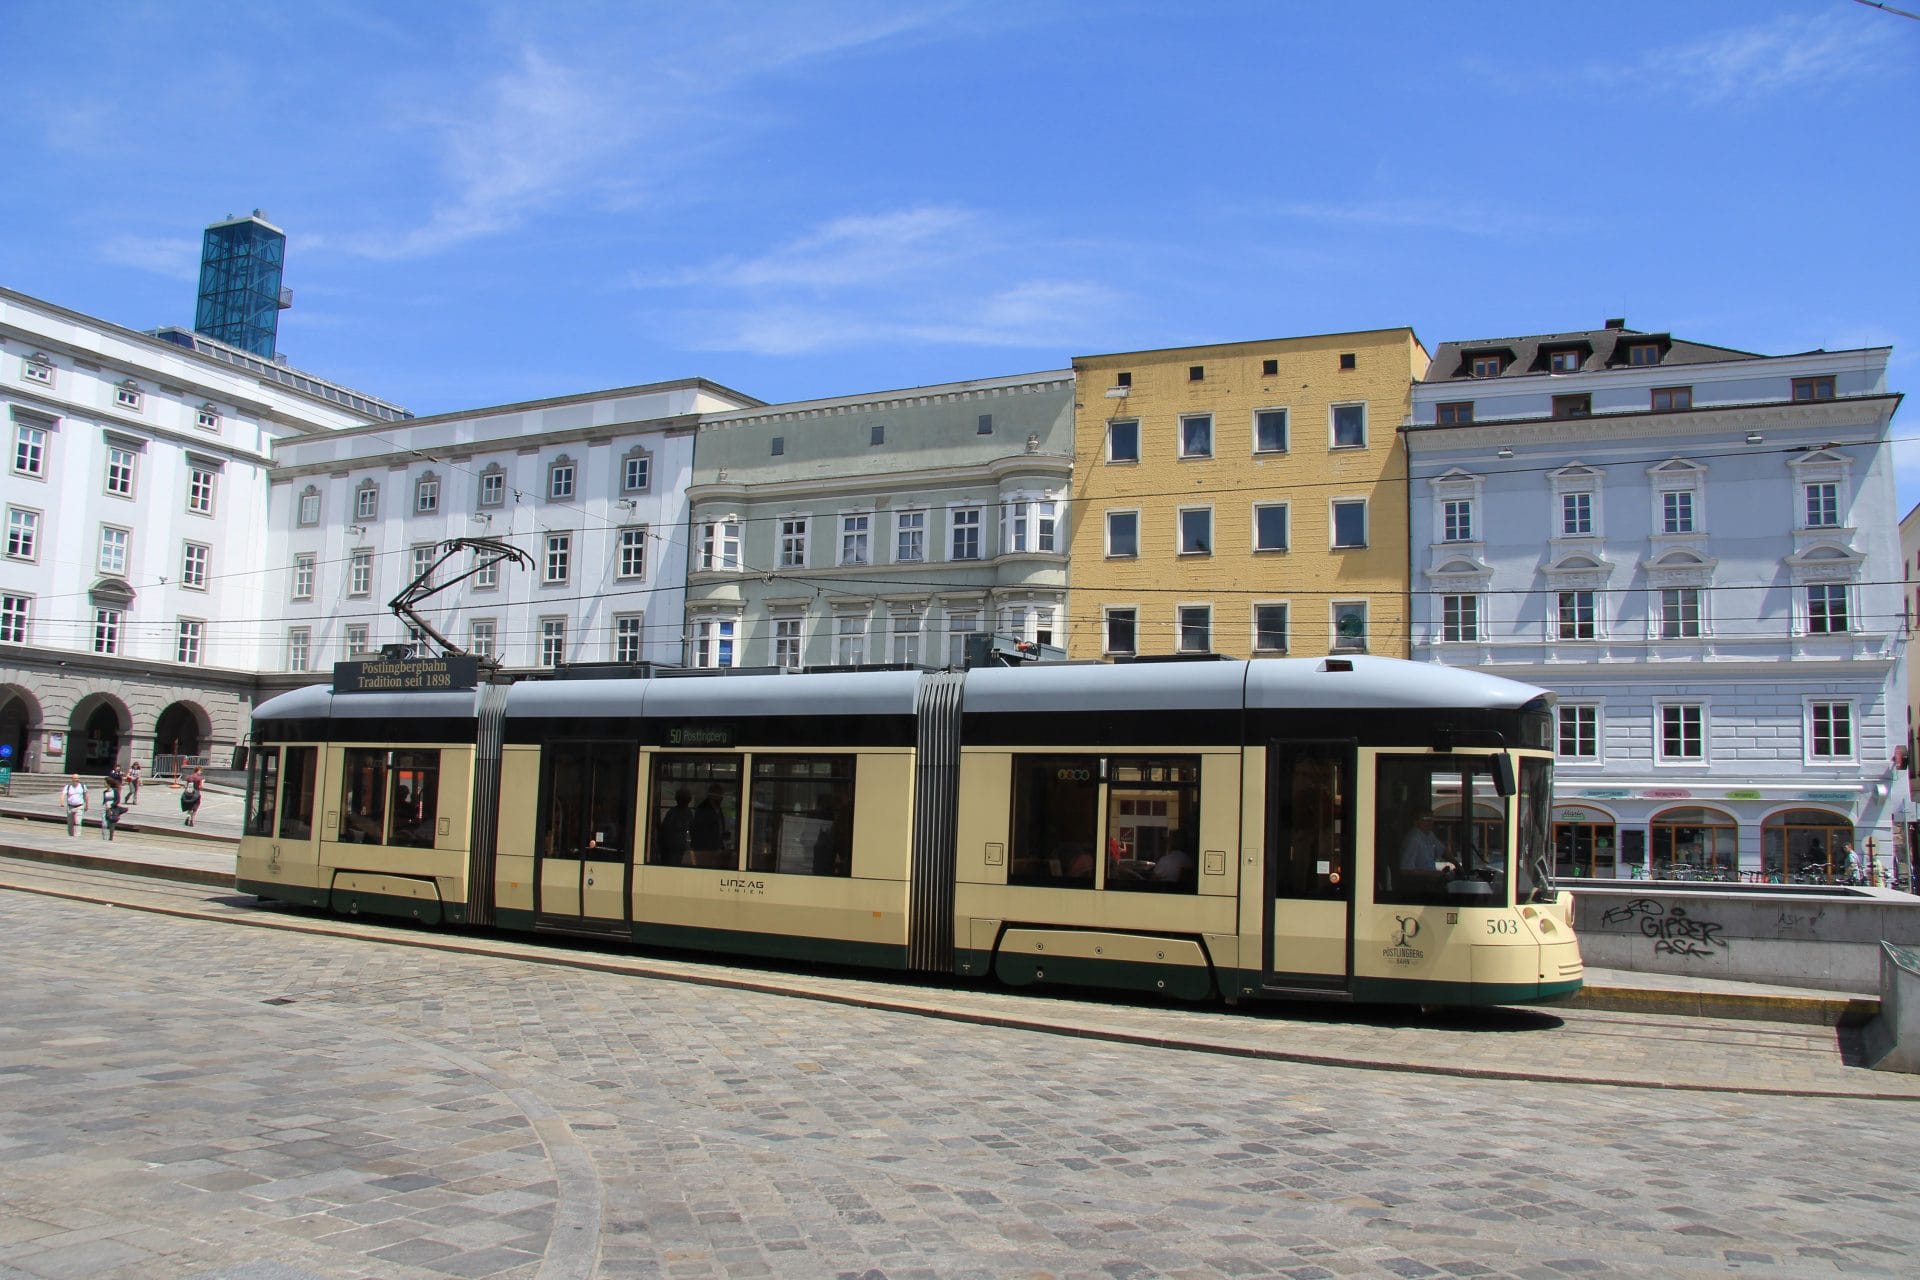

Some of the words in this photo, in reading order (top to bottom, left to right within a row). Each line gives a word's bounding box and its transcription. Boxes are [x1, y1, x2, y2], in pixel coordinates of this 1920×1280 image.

[361, 660, 447, 676] Pöstlingbergbahn
[358, 675, 402, 688] Tradition
[404, 674, 423, 687] seit
[425, 673, 451, 687] 1898
[670, 729, 682, 744] 50
[1486, 919, 1518, 935] 503
